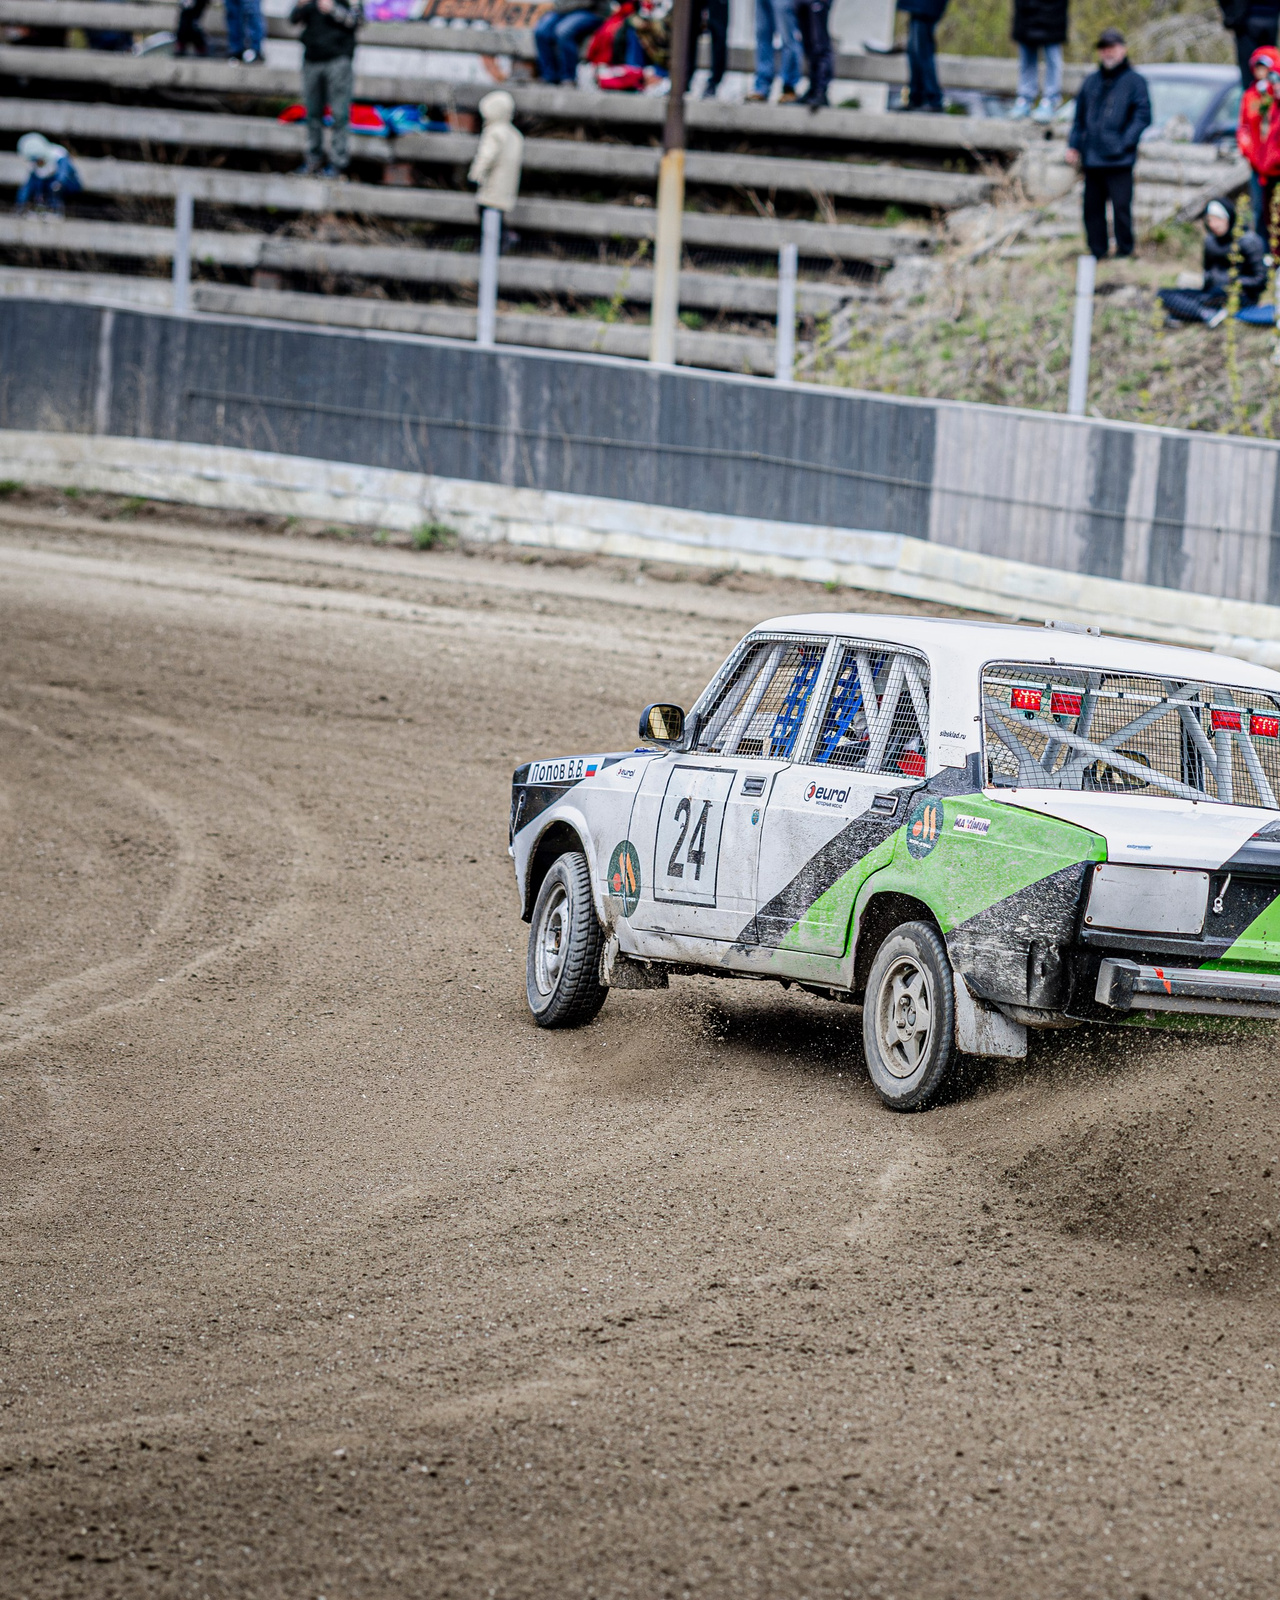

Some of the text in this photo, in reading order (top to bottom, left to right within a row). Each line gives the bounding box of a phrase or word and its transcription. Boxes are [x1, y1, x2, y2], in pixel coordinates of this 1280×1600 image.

[530, 764, 565, 782] Попов
[815, 786, 852, 803] eurol
[667, 797, 713, 881] 24
